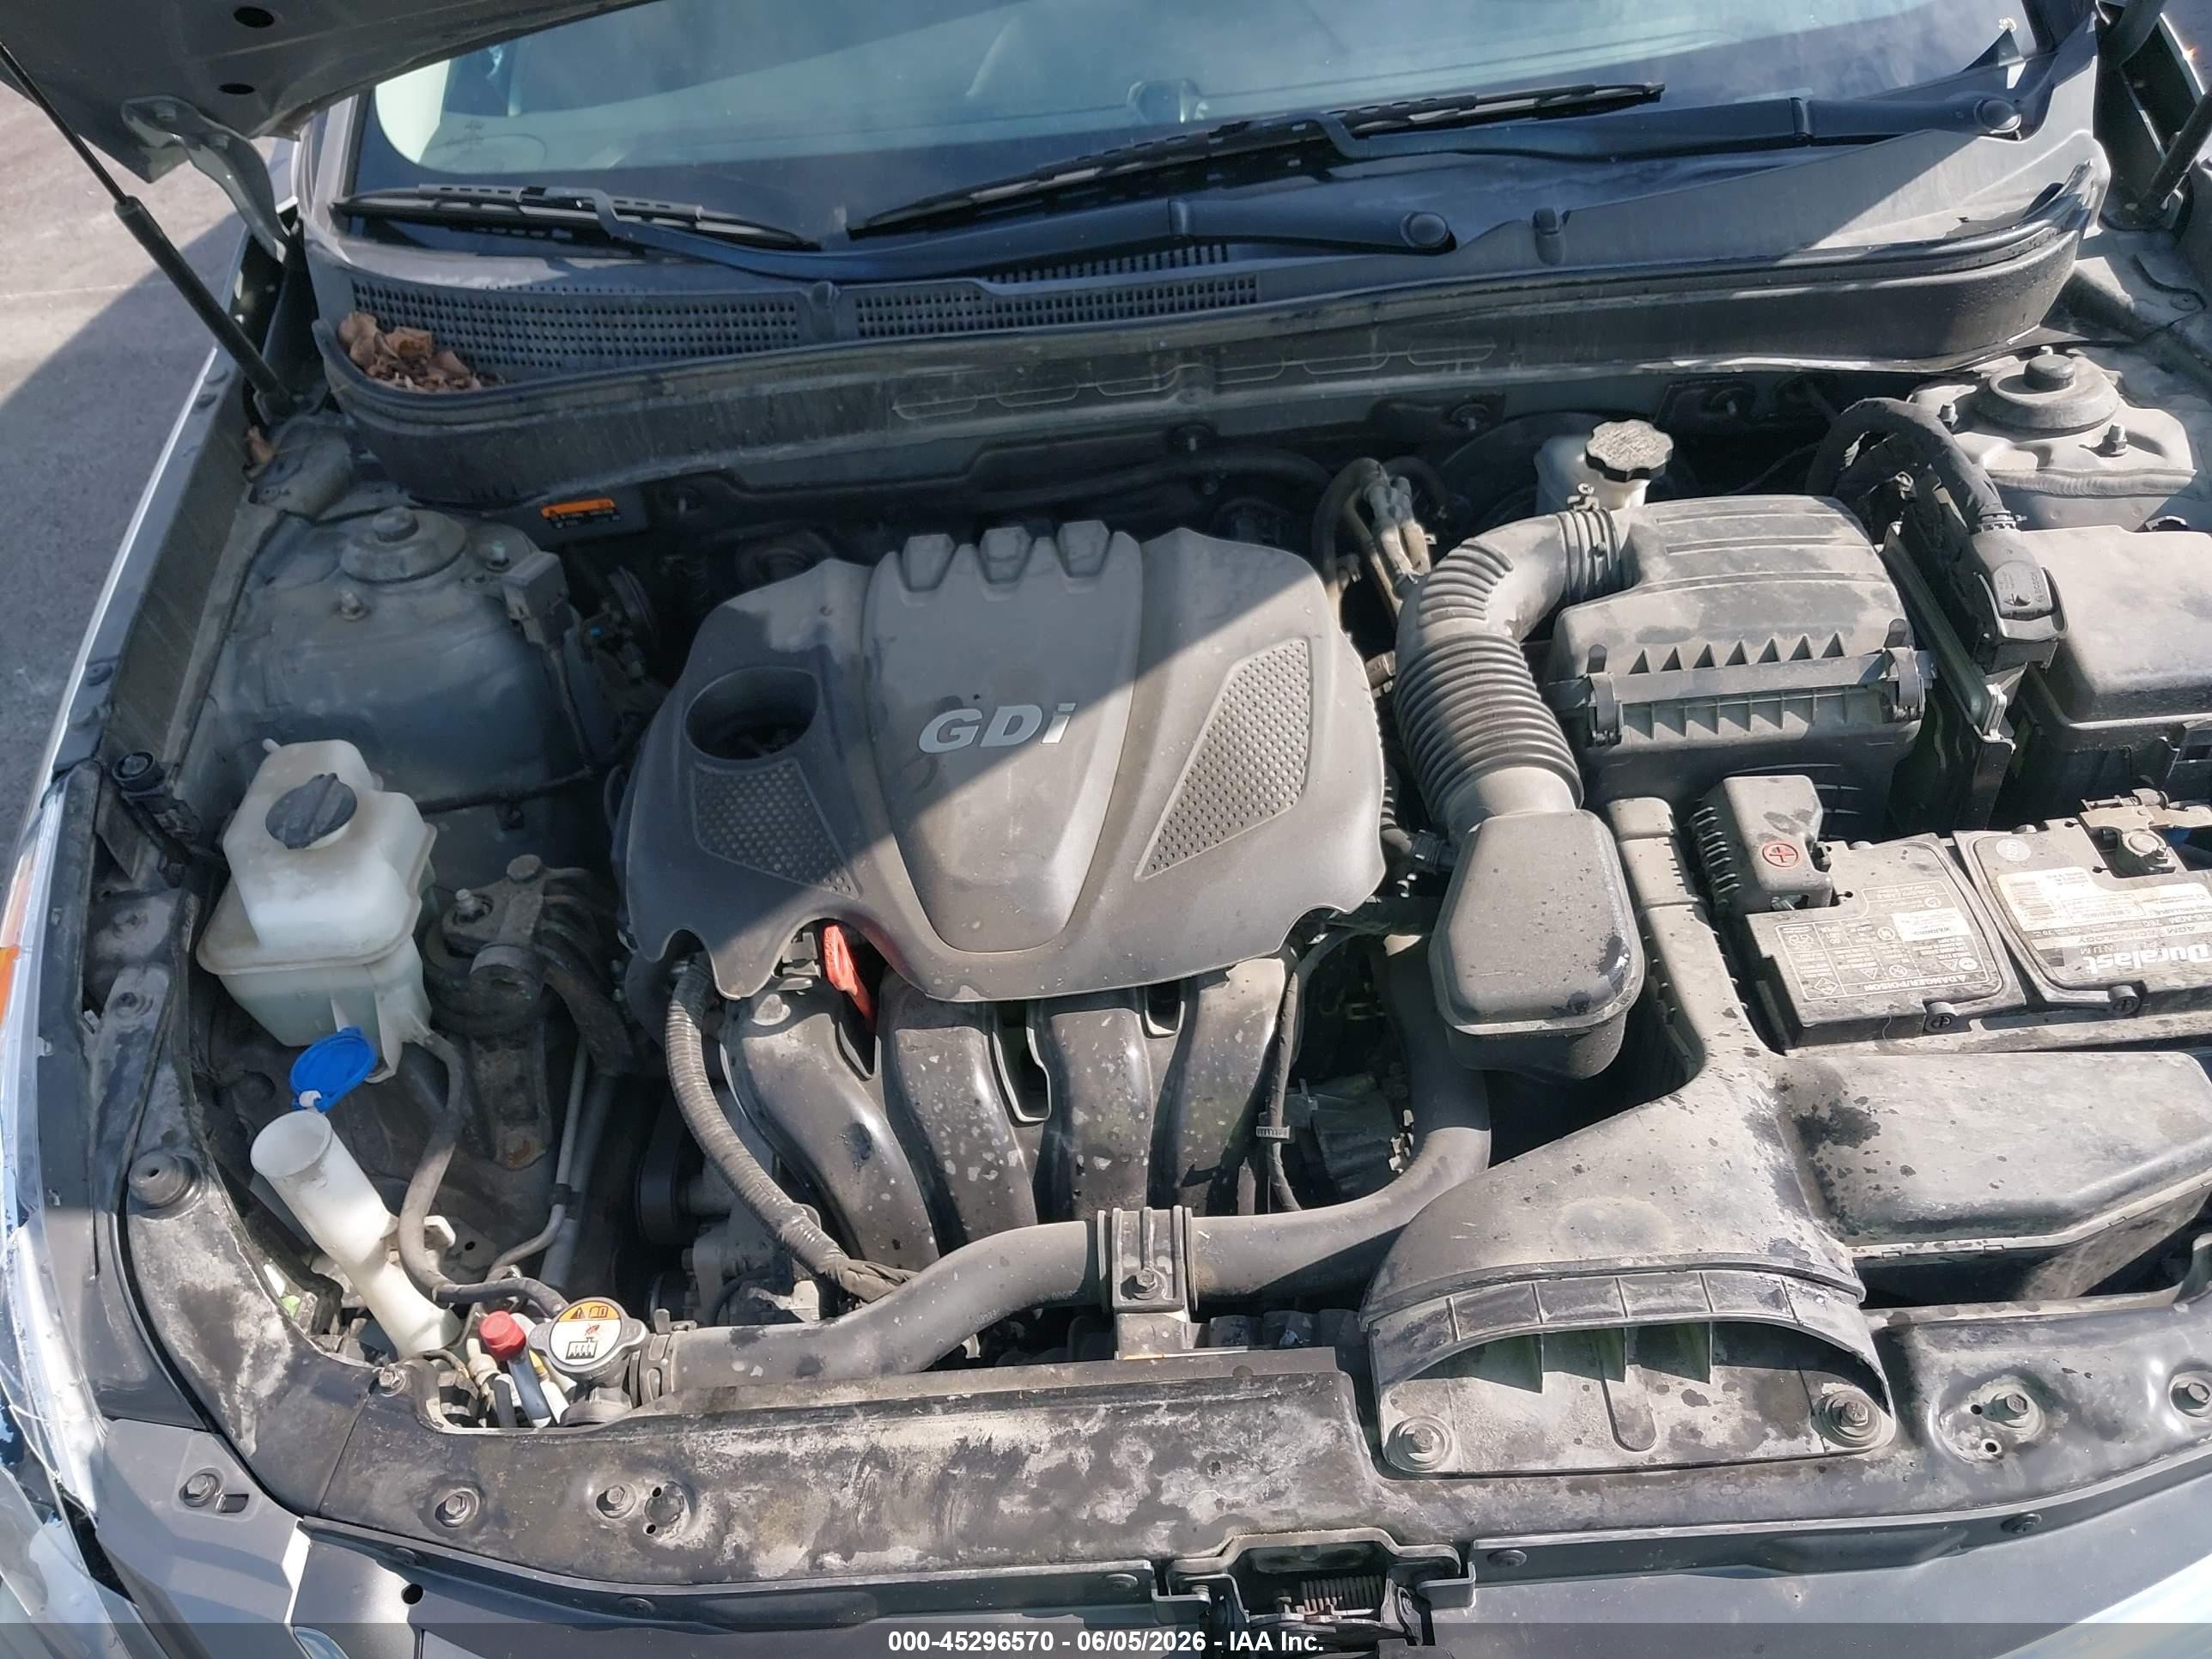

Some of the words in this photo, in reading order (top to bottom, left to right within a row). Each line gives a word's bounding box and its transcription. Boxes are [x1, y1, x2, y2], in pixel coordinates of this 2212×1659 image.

[918, 702, 1077, 754] GDi
[2167, 925, 2196, 935] AGM
[2080, 939, 2160, 956] PLNUM
[2082, 943, 2212, 975] Duralast
[1864, 975, 1959, 992] DANGER/POISON
